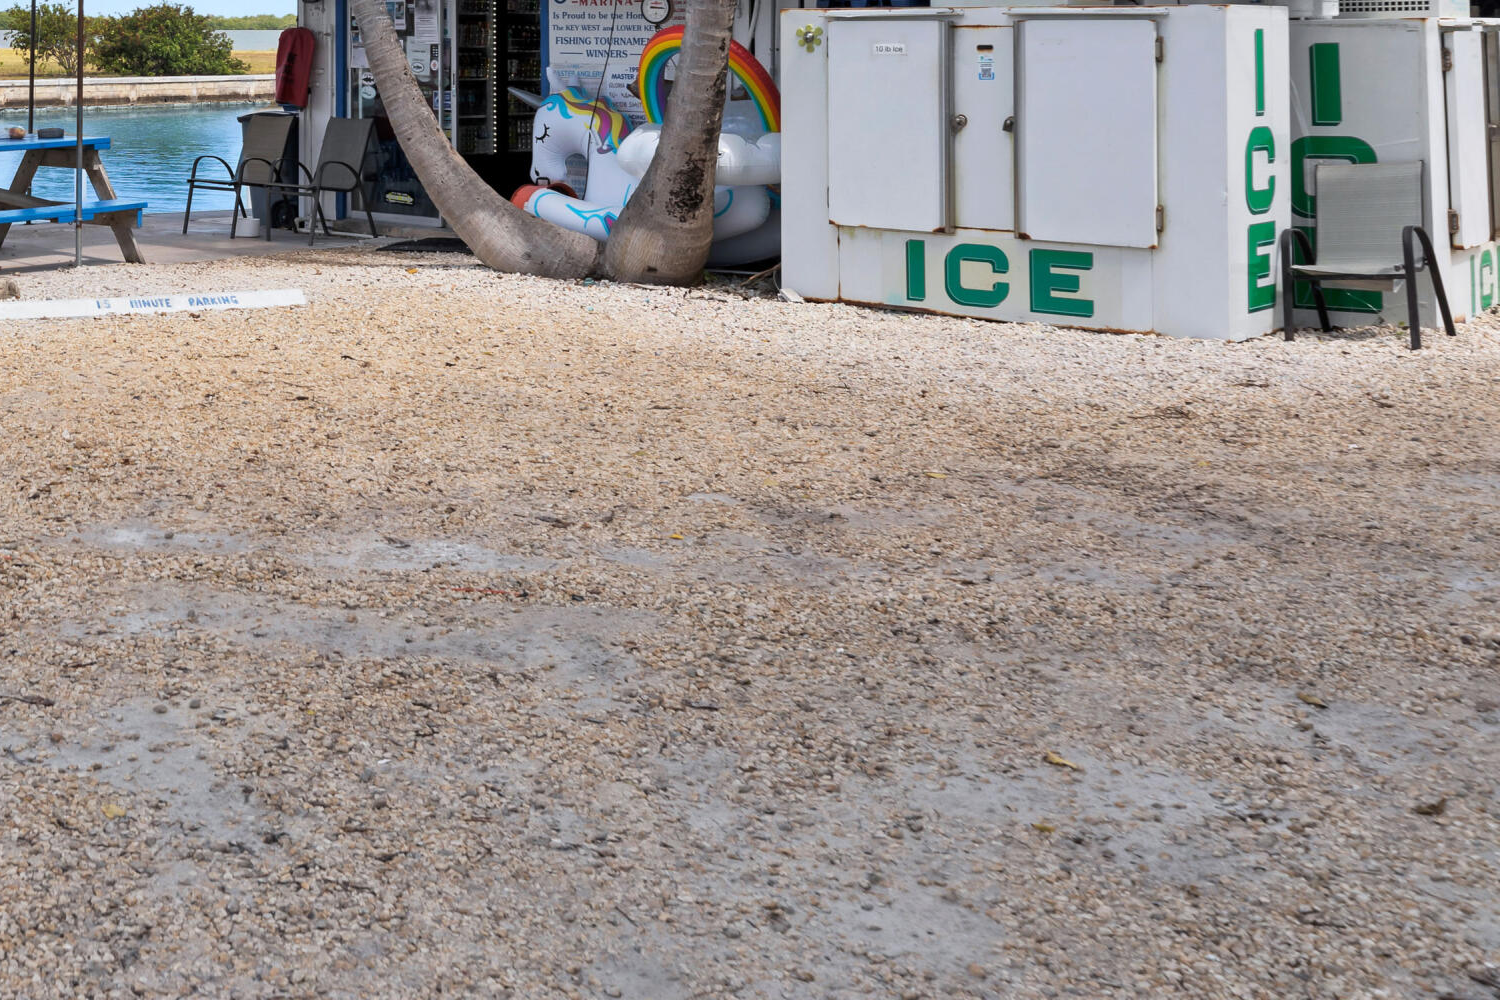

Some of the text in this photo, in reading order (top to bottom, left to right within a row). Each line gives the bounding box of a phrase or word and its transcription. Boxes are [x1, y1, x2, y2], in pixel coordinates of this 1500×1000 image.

[552, 11, 560, 19] Is
[562, 11, 585, 19] Proud
[599, 11, 608, 19] be
[611, 11, 622, 20] the
[566, 24, 580, 32] KEY
[582, 24, 601, 32] WEST
[617, 24, 642, 32] LOWER
[556, 36, 592, 46] FISHING
[586, 49, 629, 59] WINNERS
[1245, 28, 1276, 314] ICE
[906, 238, 1095, 319] ICE
[96, 295, 240, 310] 15 MINUTE PARKING
